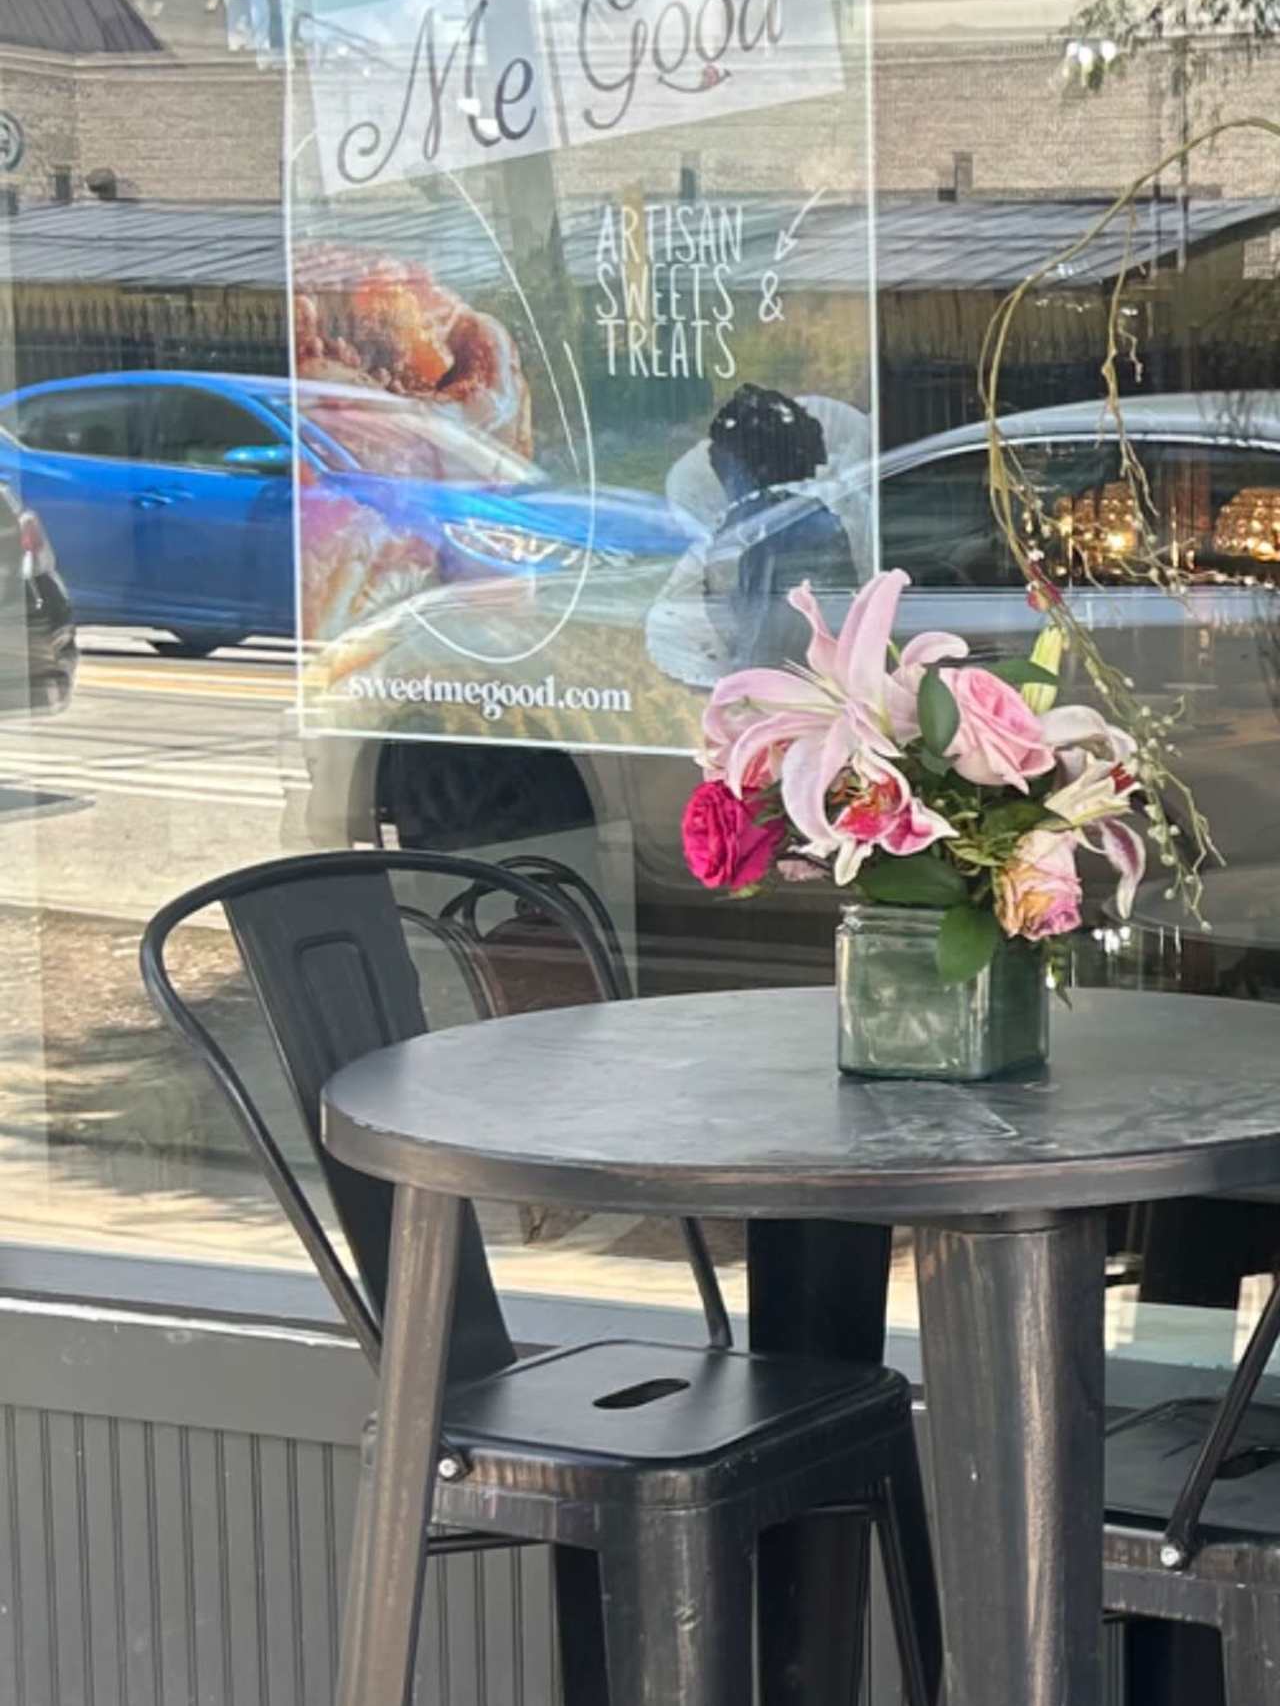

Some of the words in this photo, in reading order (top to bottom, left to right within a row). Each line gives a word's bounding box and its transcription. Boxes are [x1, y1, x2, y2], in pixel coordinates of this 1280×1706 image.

[596, 205, 743, 264] ARTISAN
[596, 262, 734, 322] SWEETS
[759, 270, 784, 323] &
[596, 319, 736, 380] TREATS
[345, 674, 633, 721] sweetmegood.com
